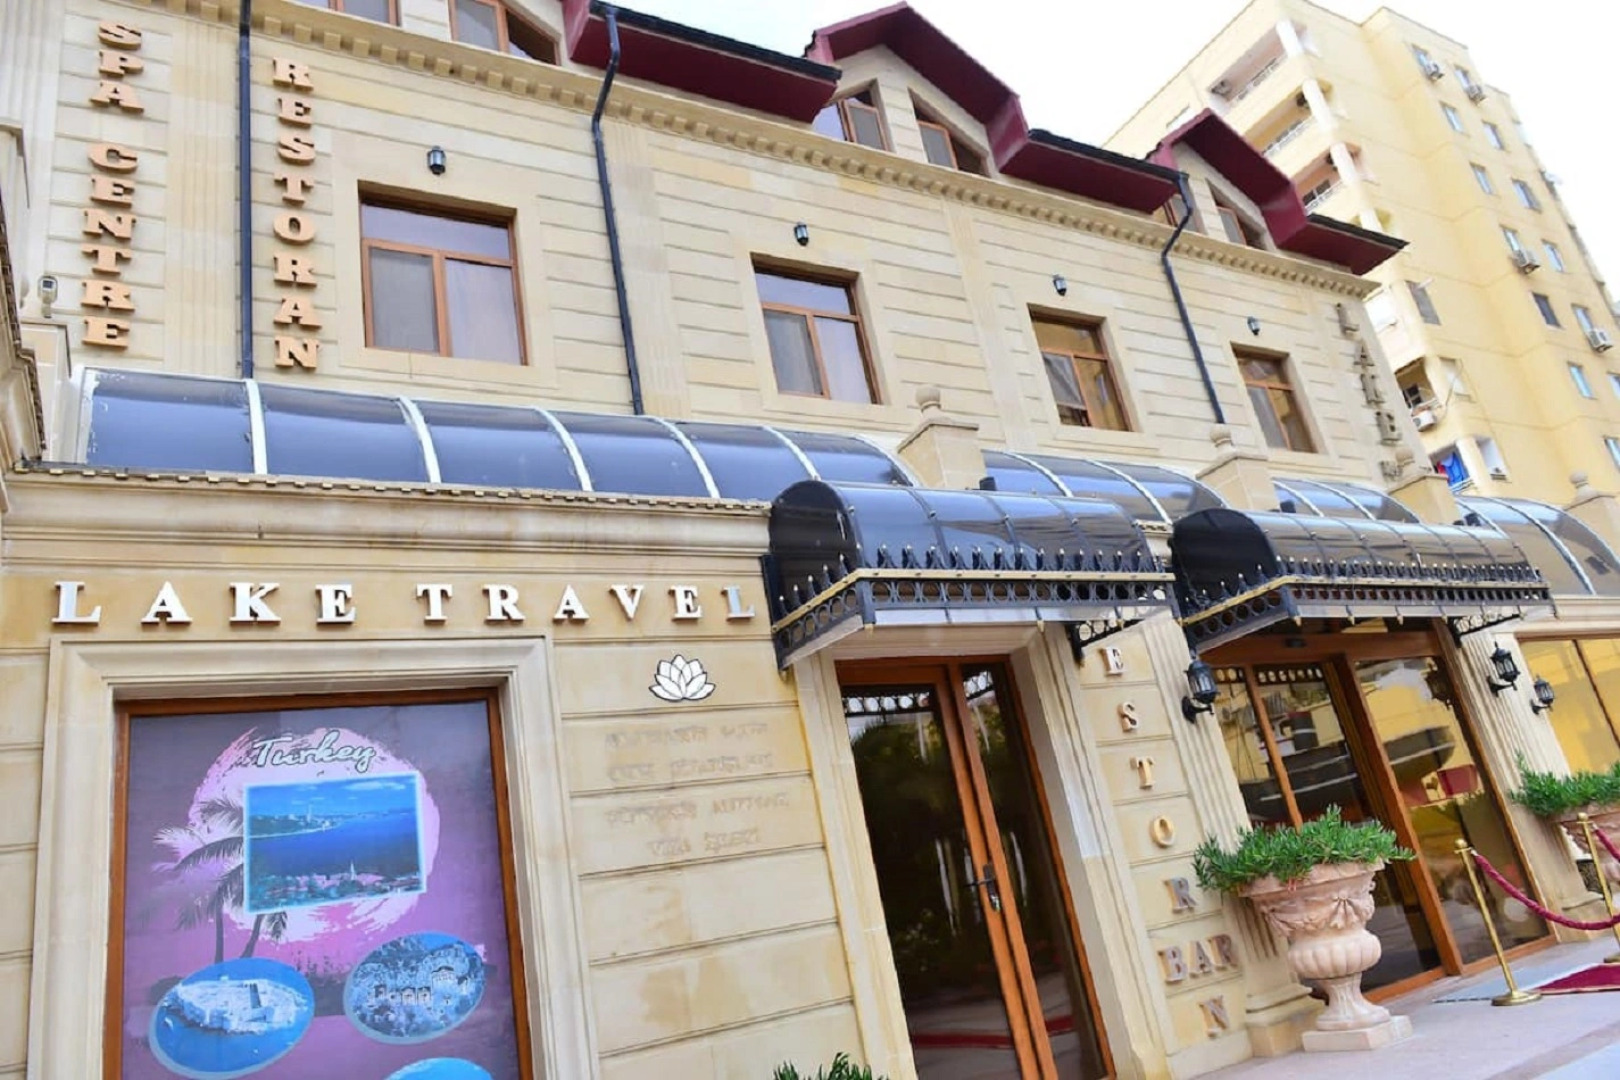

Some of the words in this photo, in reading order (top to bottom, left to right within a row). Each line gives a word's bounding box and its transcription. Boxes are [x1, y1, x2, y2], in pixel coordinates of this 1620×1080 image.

[89, 20, 144, 114] SPA
[81, 143, 139, 349] CENTRE
[272, 57, 322, 370] RESTORAN
[51, 580, 357, 625] LAKE
[415, 582, 756, 622] TRAVEL
[252, 729, 377, 773] Turkey
[1098, 645, 1232, 1038] ESTORAN
[1157, 933, 1238, 985] BAR
